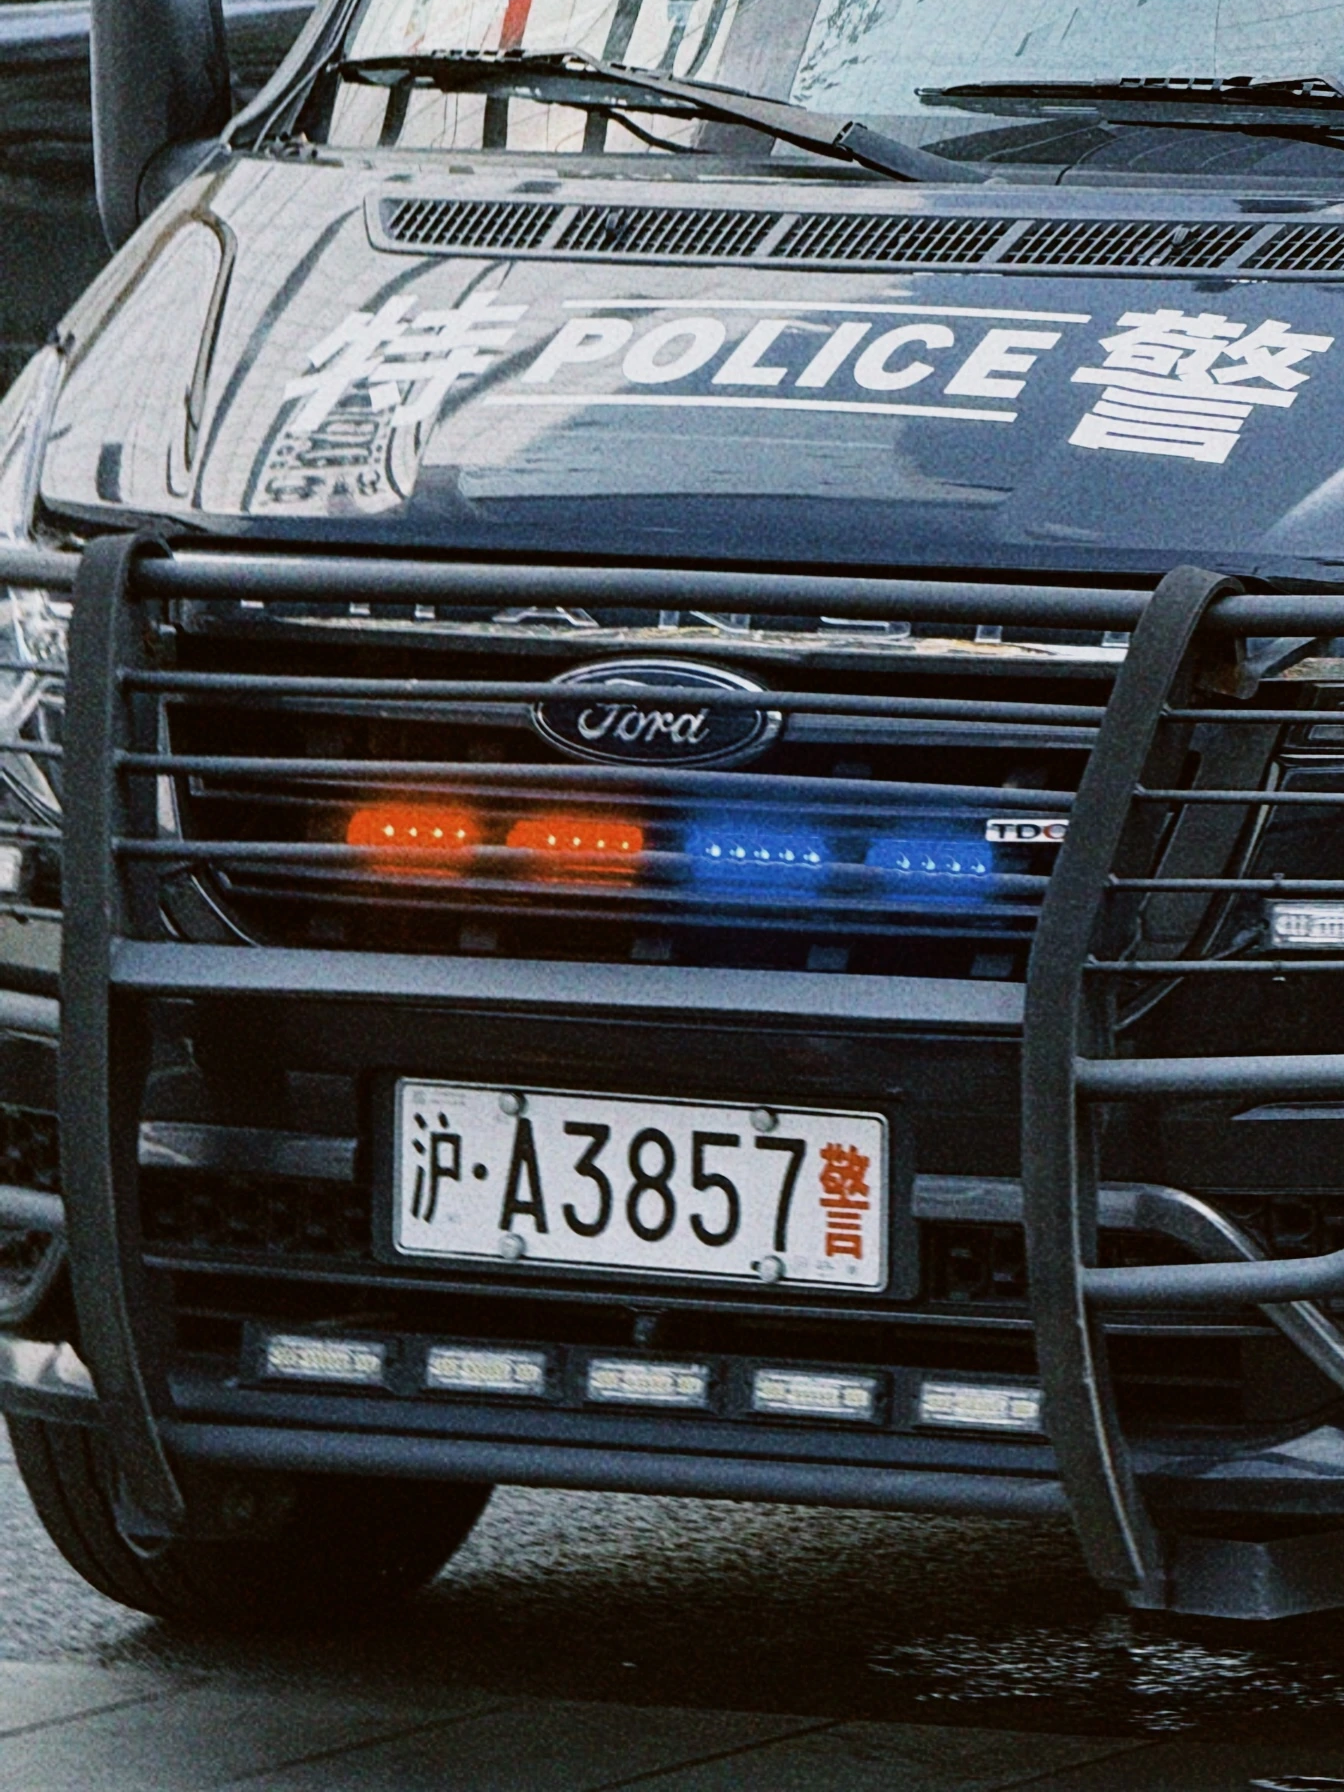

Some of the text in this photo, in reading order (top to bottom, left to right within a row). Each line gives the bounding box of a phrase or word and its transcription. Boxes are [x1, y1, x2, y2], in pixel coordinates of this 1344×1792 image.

[283, 291, 1334, 463] 特 POLICE 警
[577, 679, 710, 744] Ford
